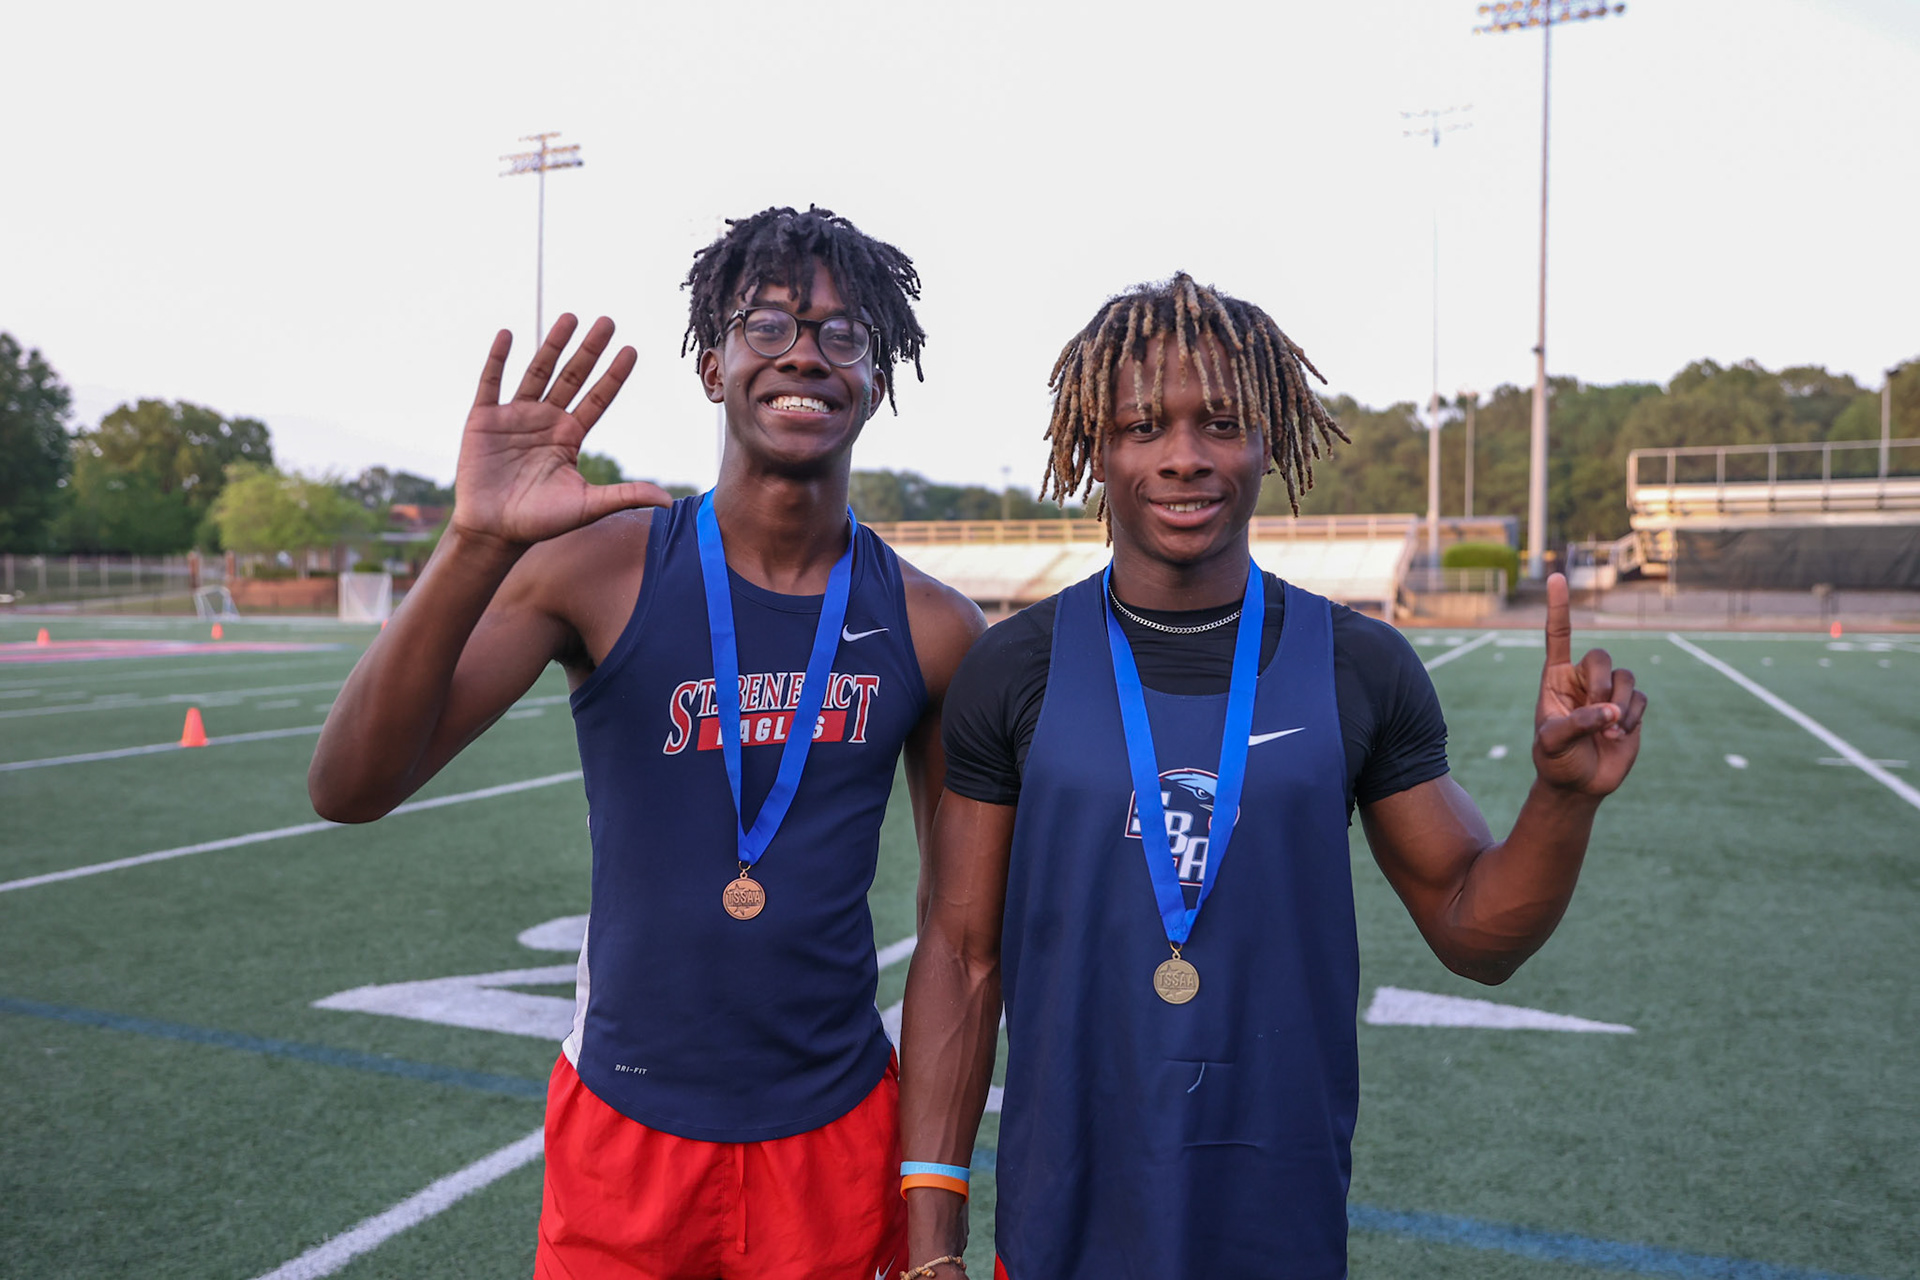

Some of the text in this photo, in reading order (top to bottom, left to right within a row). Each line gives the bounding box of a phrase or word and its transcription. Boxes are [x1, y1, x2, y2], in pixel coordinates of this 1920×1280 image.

[737, 672, 880, 743] BENEICT
[716, 715, 826, 746] AGLS
[727, 890, 761, 904] TSSAA
[615, 1064, 647, 1075] DRI-FIT
